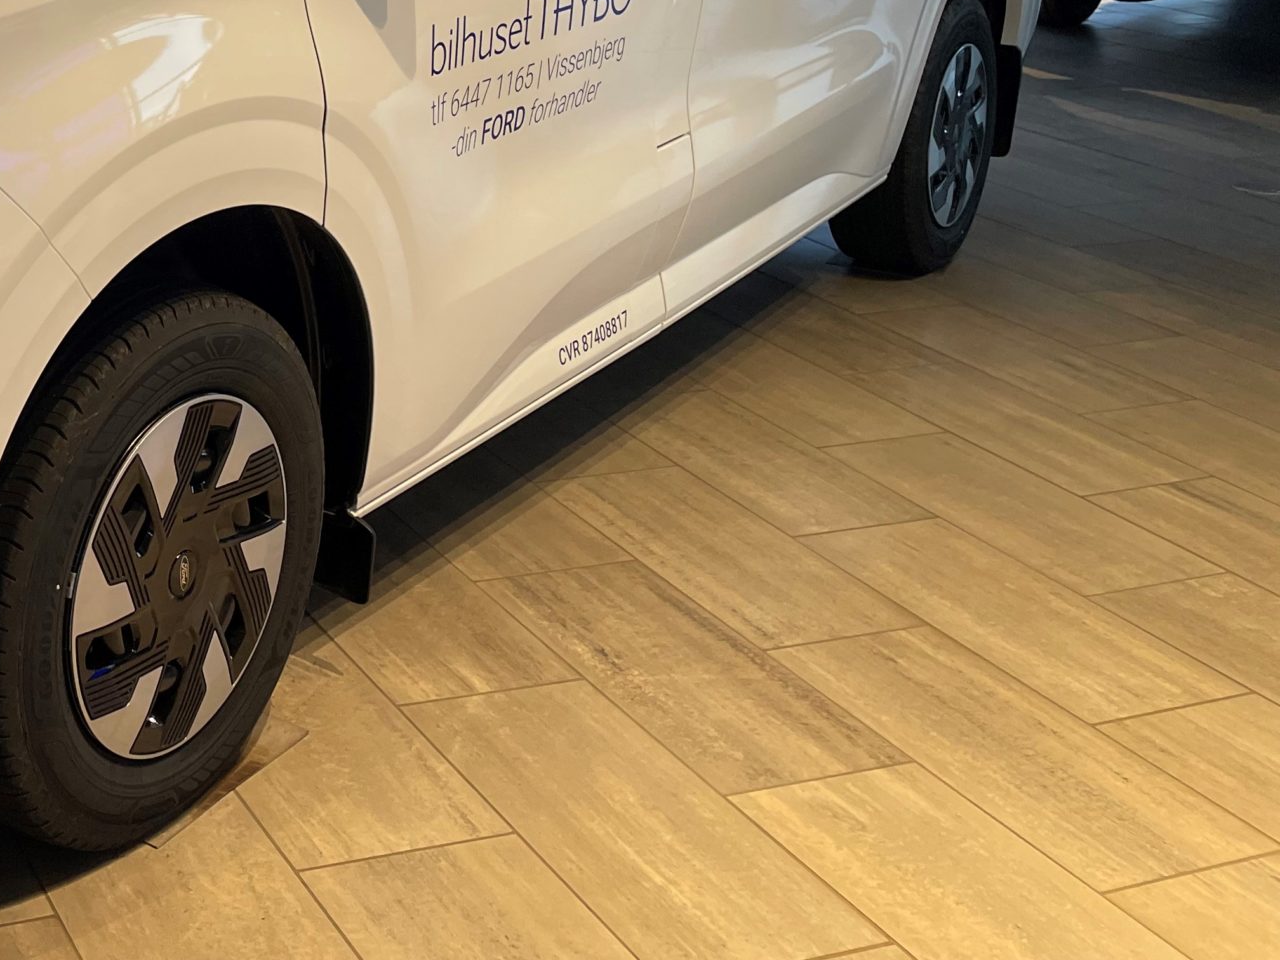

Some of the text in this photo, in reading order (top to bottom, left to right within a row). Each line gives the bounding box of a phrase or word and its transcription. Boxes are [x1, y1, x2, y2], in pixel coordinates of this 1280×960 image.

[431, 92, 448, 126] tlf
[450, 78, 491, 117] 6447
[496, 62, 535, 99] 1165
[547, 36, 626, 81] Vissenbjerg
[451, 80, 602, 157] -din FORD forhandler
[558, 309, 628, 365] CVR 87408817
